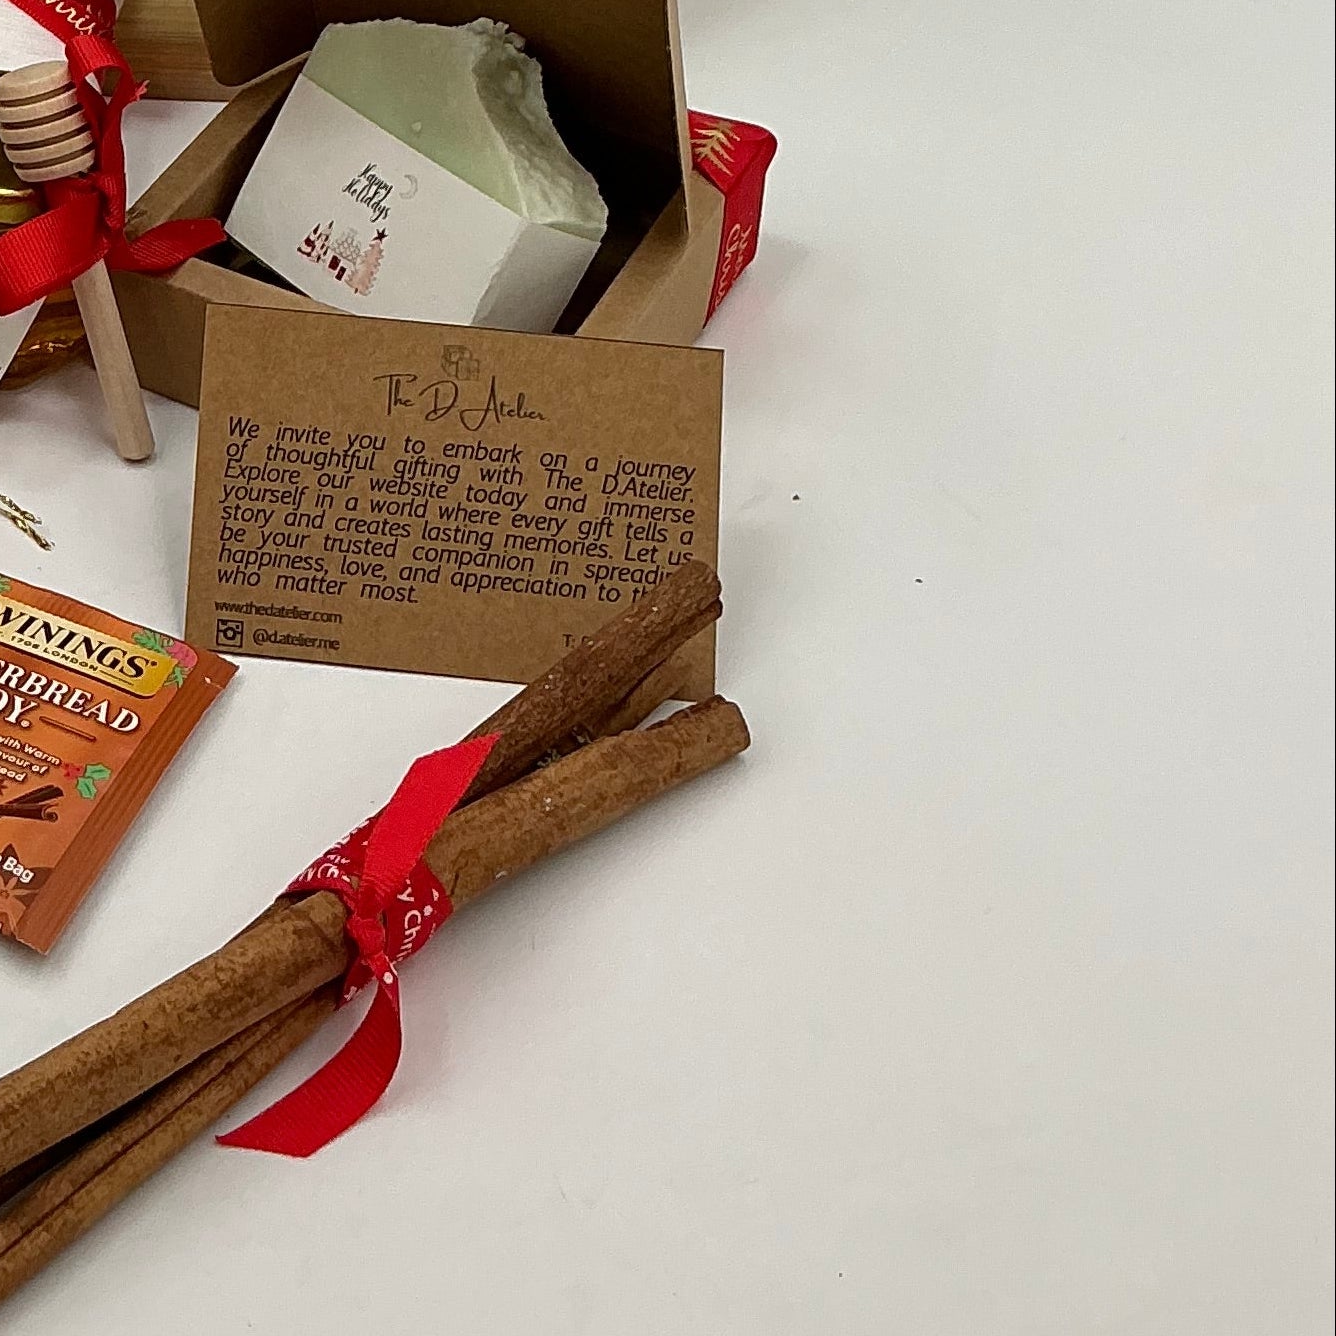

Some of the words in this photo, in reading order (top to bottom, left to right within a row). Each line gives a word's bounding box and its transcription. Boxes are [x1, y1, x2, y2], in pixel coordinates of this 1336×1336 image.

[373, 373, 419, 416] The
[459, 375, 549, 431] Atelier
[226, 441, 248, 462] of
[266, 442, 376, 472] thoughtful
[393, 457, 461, 484] gifting
[480, 465, 524, 486] with
[546, 468, 583, 492] The
[228, 416, 260, 438] We
[275, 421, 331, 445] invite
[347, 433, 386, 451] you
[404, 435, 426, 454] to
[442, 440, 524, 464] embark
[540, 451, 568, 469] on
[585, 456, 599, 471] a
[615, 455, 696, 486] journey
[218, 482, 308, 511] yourself
[315, 489, 334, 509] in
[345, 496, 359, 511] a
[369, 497, 428, 518] world
[439, 502, 500, 525] where
[511, 513, 567, 537] every
[578, 515, 614, 541] gift
[625, 521, 668, 544] tells
[680, 530, 693, 545] a
[224, 458, 301, 485] Explore
[317, 473, 354, 489] our
[369, 476, 448, 499] website
[465, 484, 528, 509] today
[544, 495, 587, 513] and
[603, 496, 695, 524] immerse
[219, 523, 246, 543] be
[260, 529, 310, 549] your
[323, 534, 398, 558] trusted
[412, 546, 534, 572] companion
[550, 555, 569, 575] in
[221, 504, 274, 528] story
[284, 510, 325, 530] and
[334, 517, 411, 538] creates
[422, 521, 493, 549] lasting
[504, 534, 613, 560] memories.
[625, 543, 658, 564] Let
[217, 567, 261, 587] who
[275, 574, 347, 596] matter
[360, 581, 419, 604] most.
[218, 544, 329, 575] happiness,
[340, 555, 388, 580] love,
[399, 563, 441, 584] and
[451, 568, 587, 600] appreciation
[598, 583, 621, 603] to
[43, 647, 99, 673] LONDON
[24, 743, 62, 766] Warm
[32, 763, 49, 775] of
[2, 856, 34, 884] Bag
